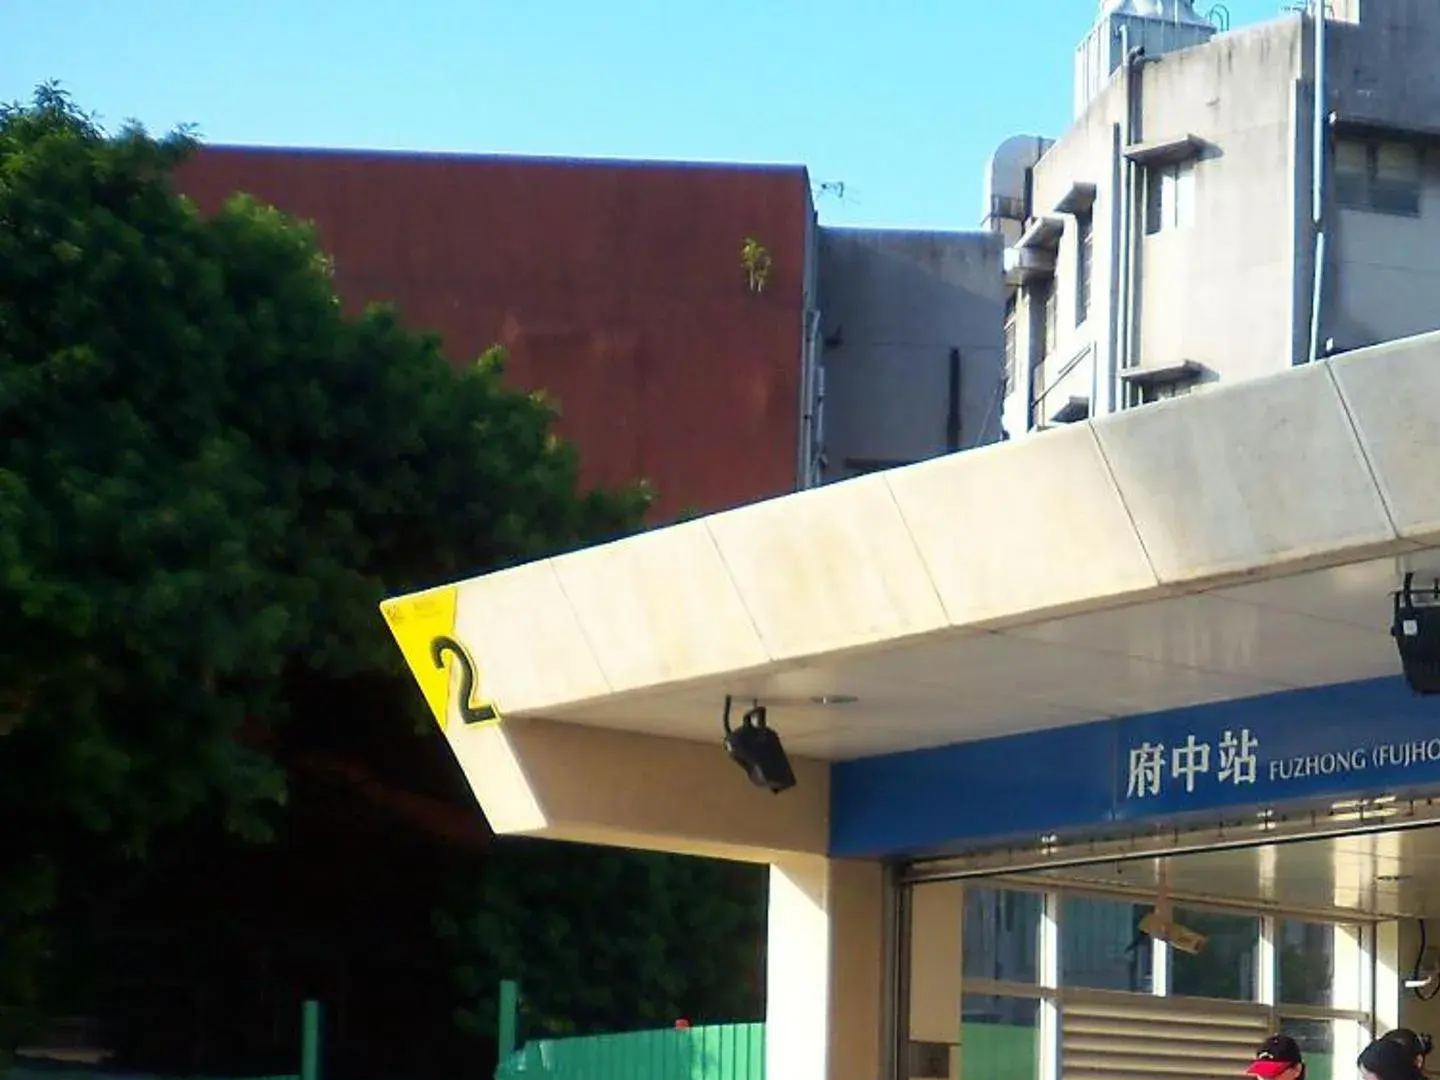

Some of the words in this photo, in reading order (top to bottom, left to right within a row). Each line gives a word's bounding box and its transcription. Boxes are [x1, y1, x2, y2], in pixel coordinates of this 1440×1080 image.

[431, 635, 497, 725] 2
[1126, 729, 1259, 799] 府中站
[1268, 749, 1367, 781] FUZHONG
